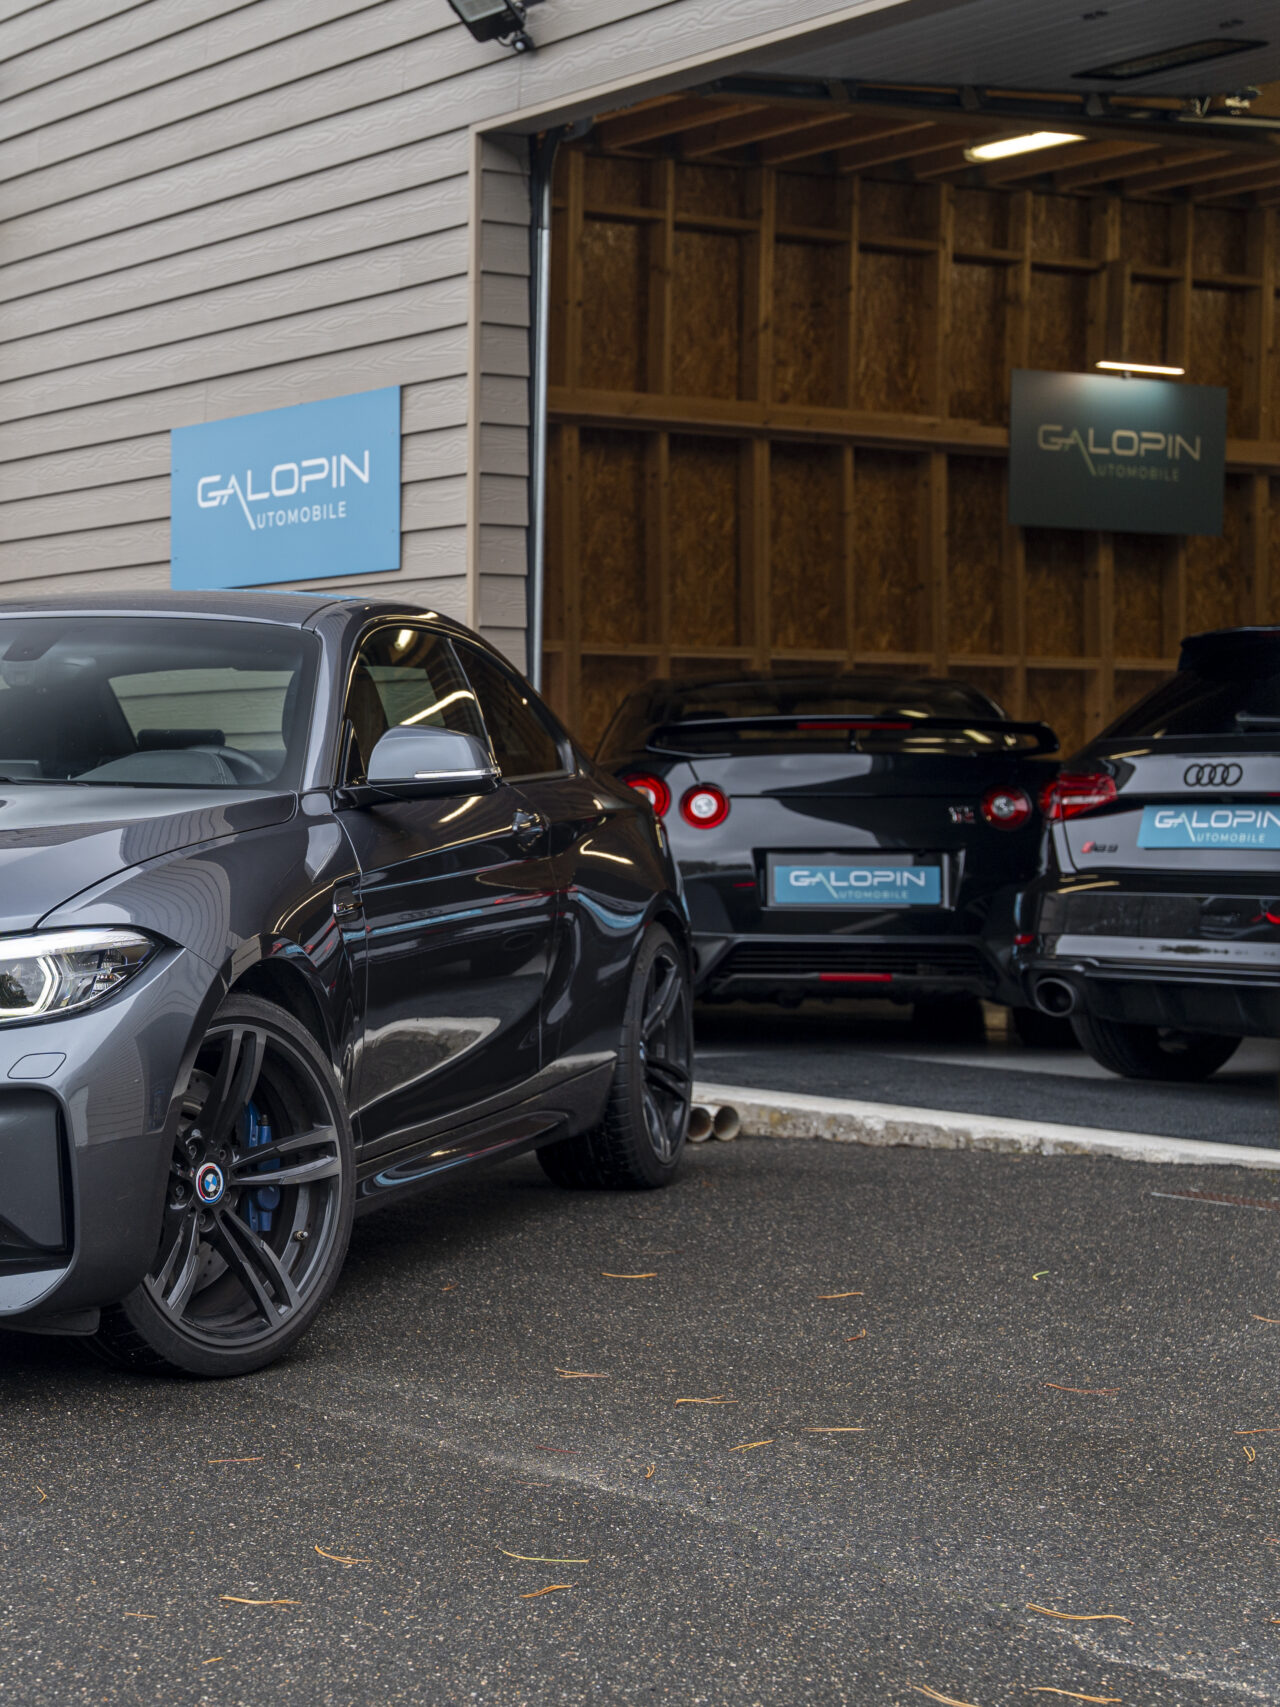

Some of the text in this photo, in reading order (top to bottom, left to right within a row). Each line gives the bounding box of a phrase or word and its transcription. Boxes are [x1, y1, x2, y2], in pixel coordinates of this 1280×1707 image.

[1037, 424, 1202, 476] GALOPIN
[197, 449, 370, 531] GALOPIN
[789, 870, 926, 898] GALOPIN
